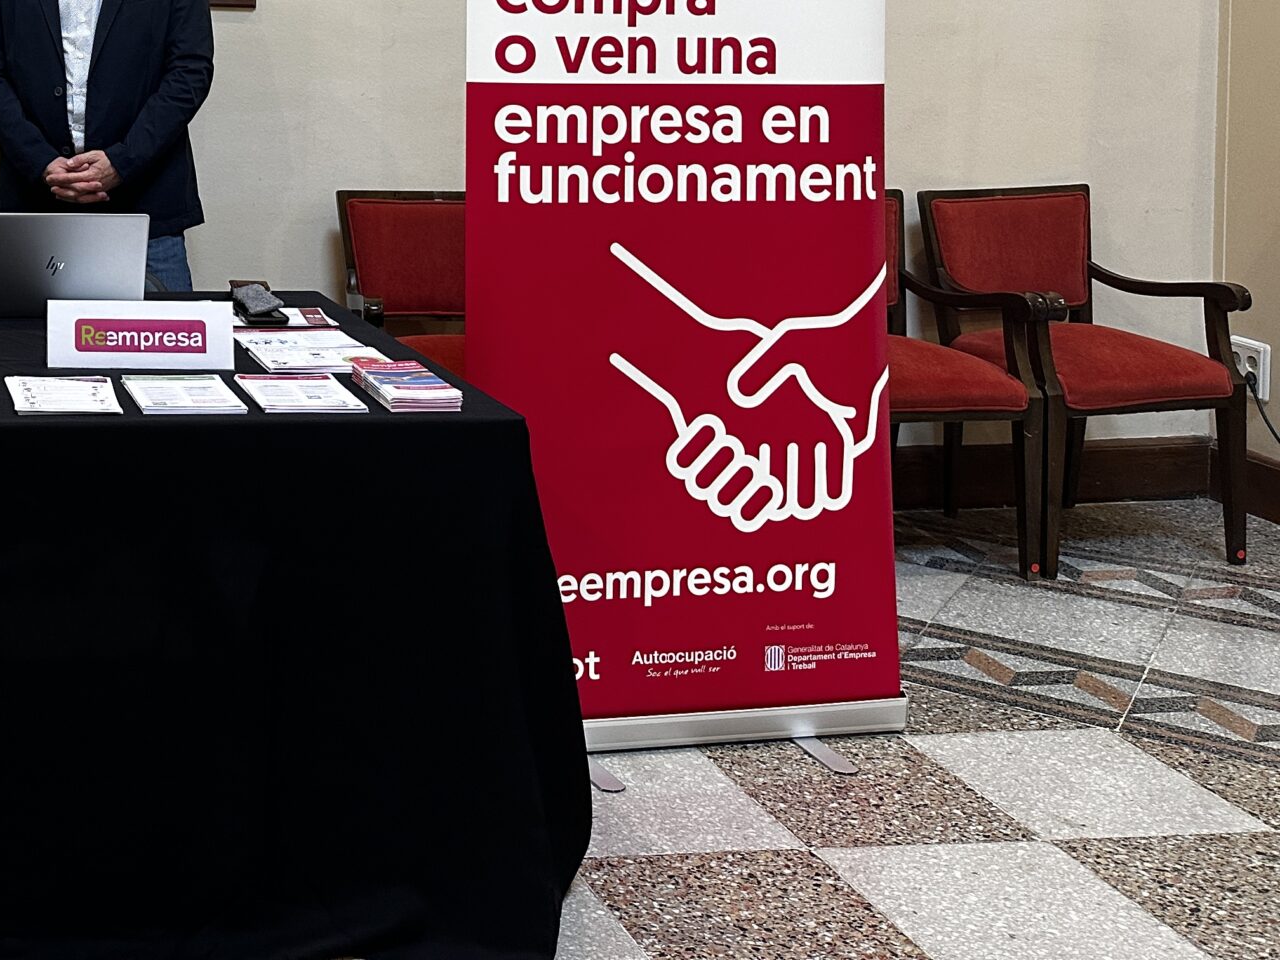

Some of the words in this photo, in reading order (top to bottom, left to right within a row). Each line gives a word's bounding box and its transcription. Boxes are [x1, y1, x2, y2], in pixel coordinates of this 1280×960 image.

[494, 34, 537, 74] o
[555, 35, 657, 74] ven
[676, 37, 777, 75] una
[494, 104, 743, 156] empresa
[761, 105, 831, 144] en
[494, 151, 877, 204] funcionament
[81, 325, 203, 351] Reempresa
[557, 561, 836, 607] eempresa.org
[631, 645, 737, 665] Autoocupació
[787, 645, 823, 654] Generalitat
[824, 644, 834, 652] de
[835, 643, 869, 652] Catalunya
[787, 652, 836, 662] Departament
[837, 651, 877, 660] d'Empresa
[792, 661, 816, 670] Treball
